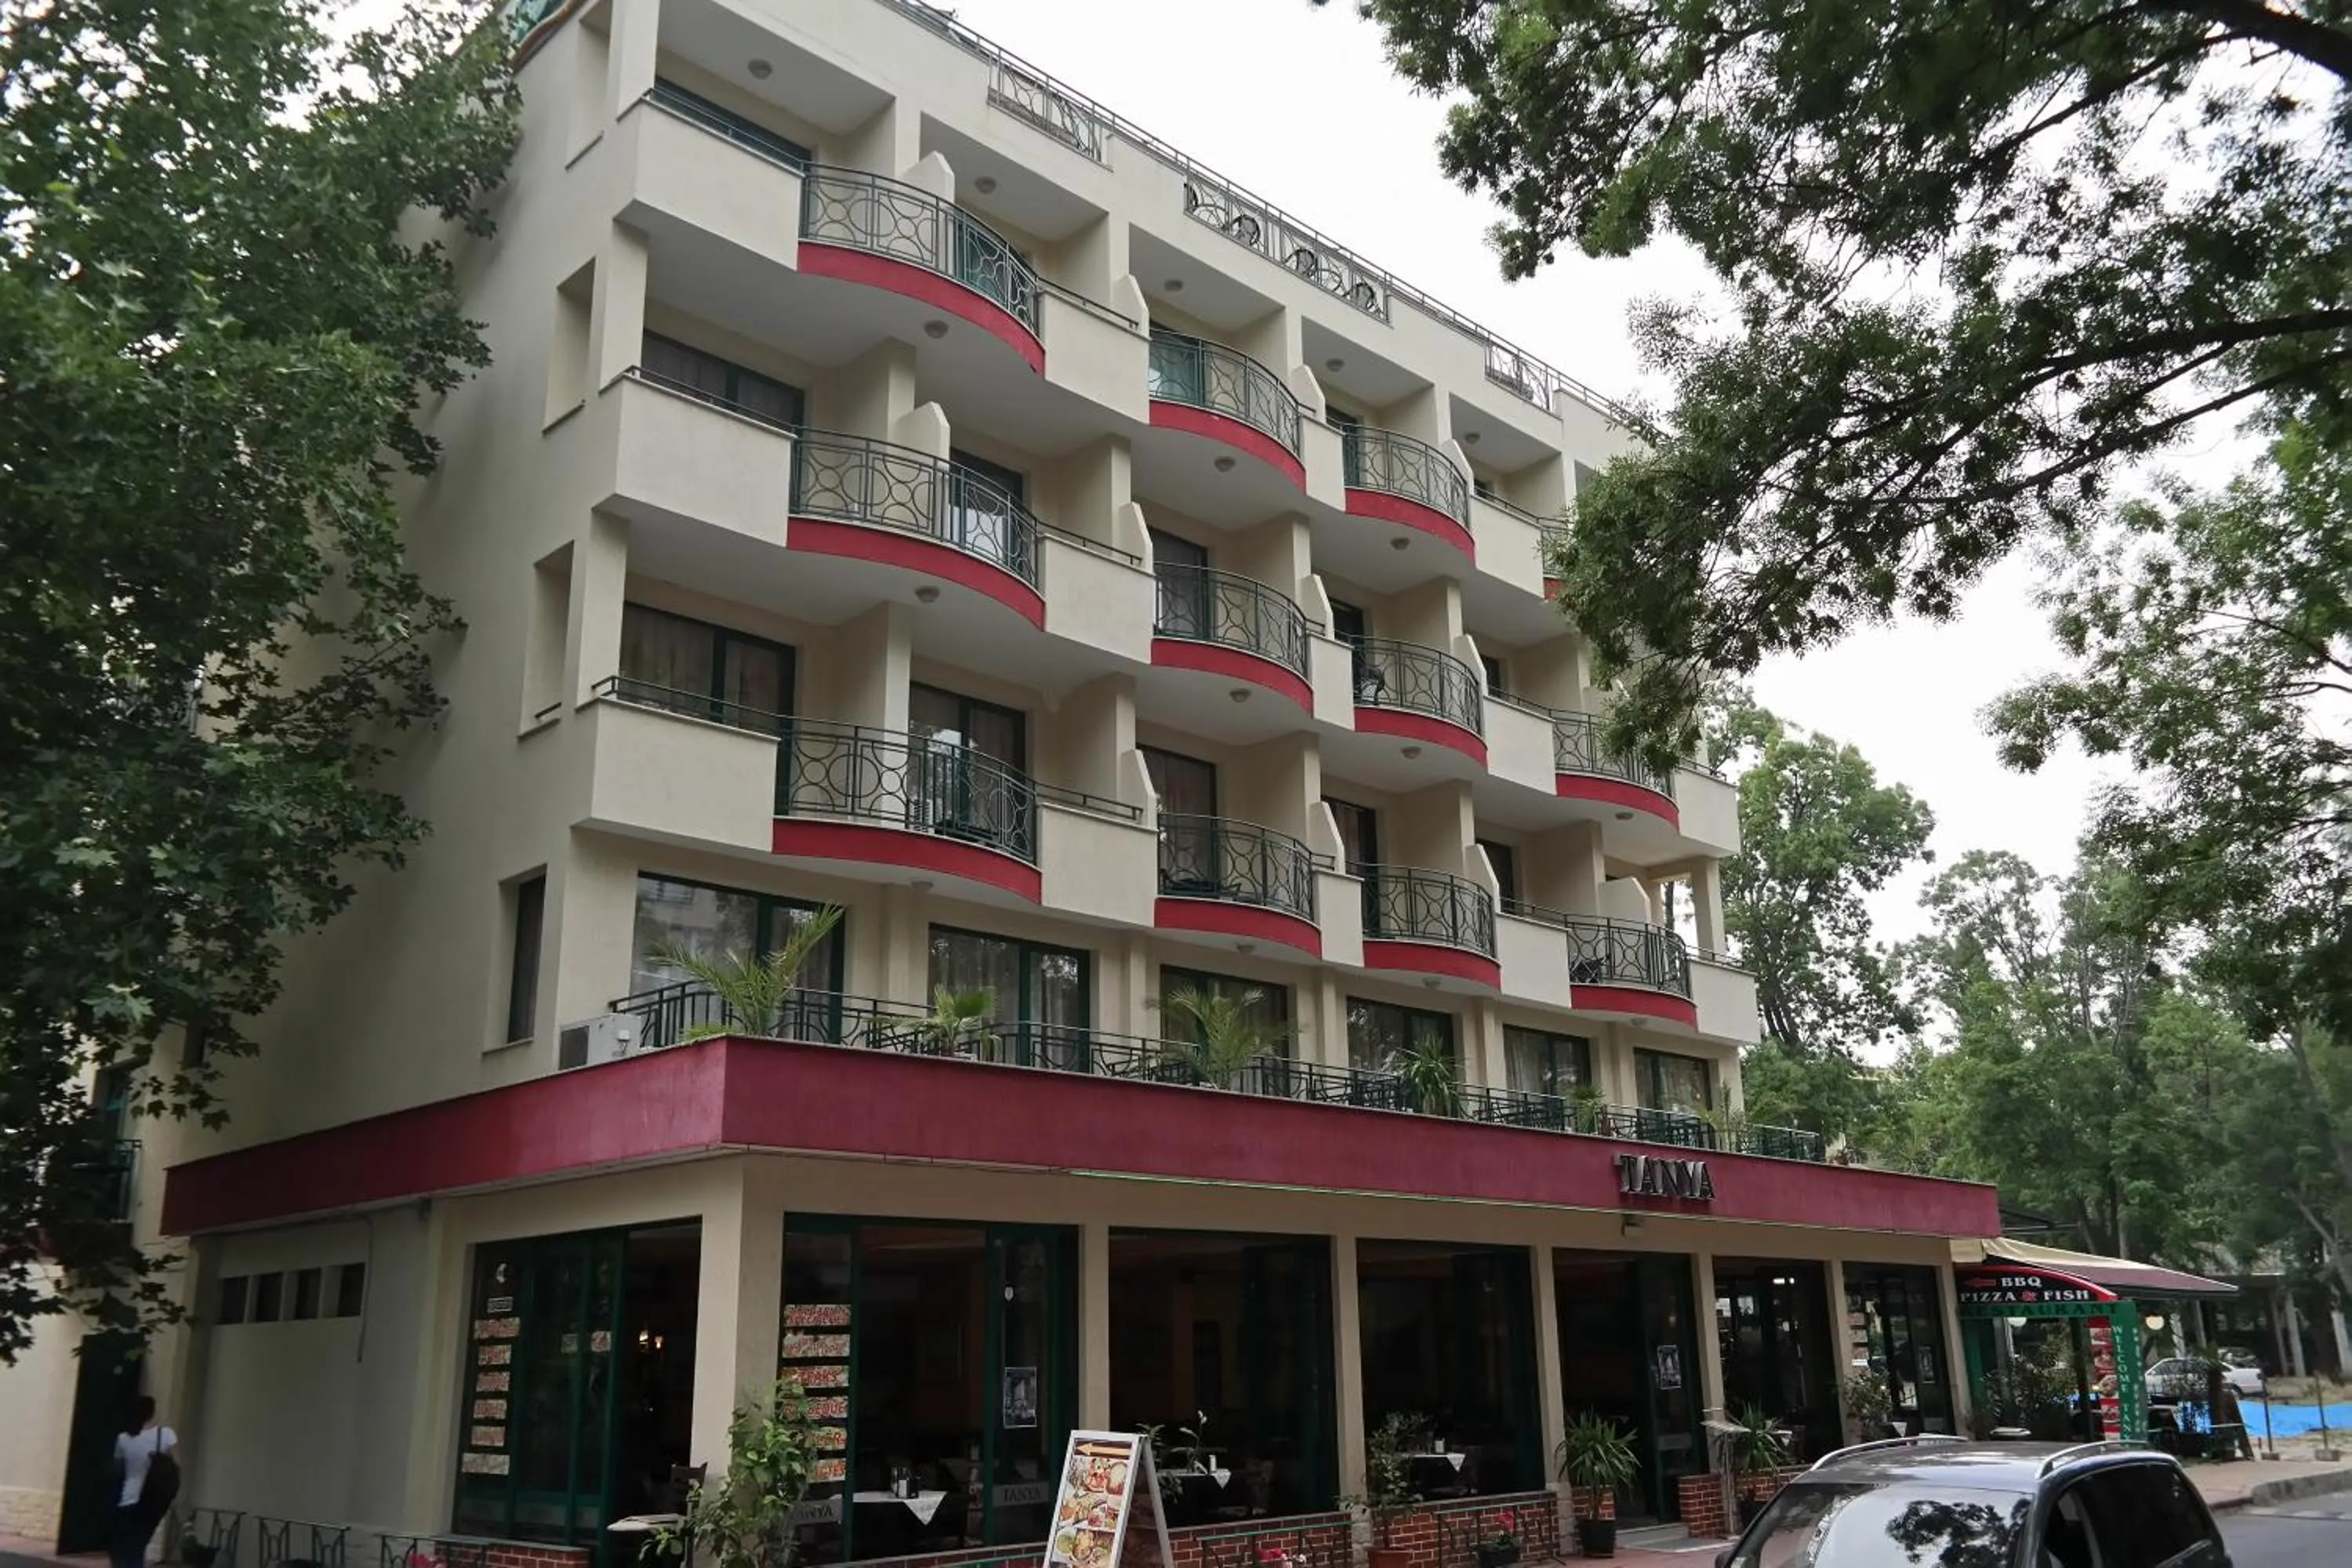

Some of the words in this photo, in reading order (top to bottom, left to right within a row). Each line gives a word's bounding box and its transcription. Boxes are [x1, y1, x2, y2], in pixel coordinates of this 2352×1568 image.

[1614, 1153, 1716, 1200] TANYA
[2001, 1276, 2042, 1288] BBQ
[1961, 1292, 2016, 1302] PIZZA
[2044, 1290, 2089, 1301] FISH
[2112, 1326, 2130, 1393] WELCOME
[1002, 1486, 1041, 1503] TANYA
[791, 1504, 833, 1519] ANYA
